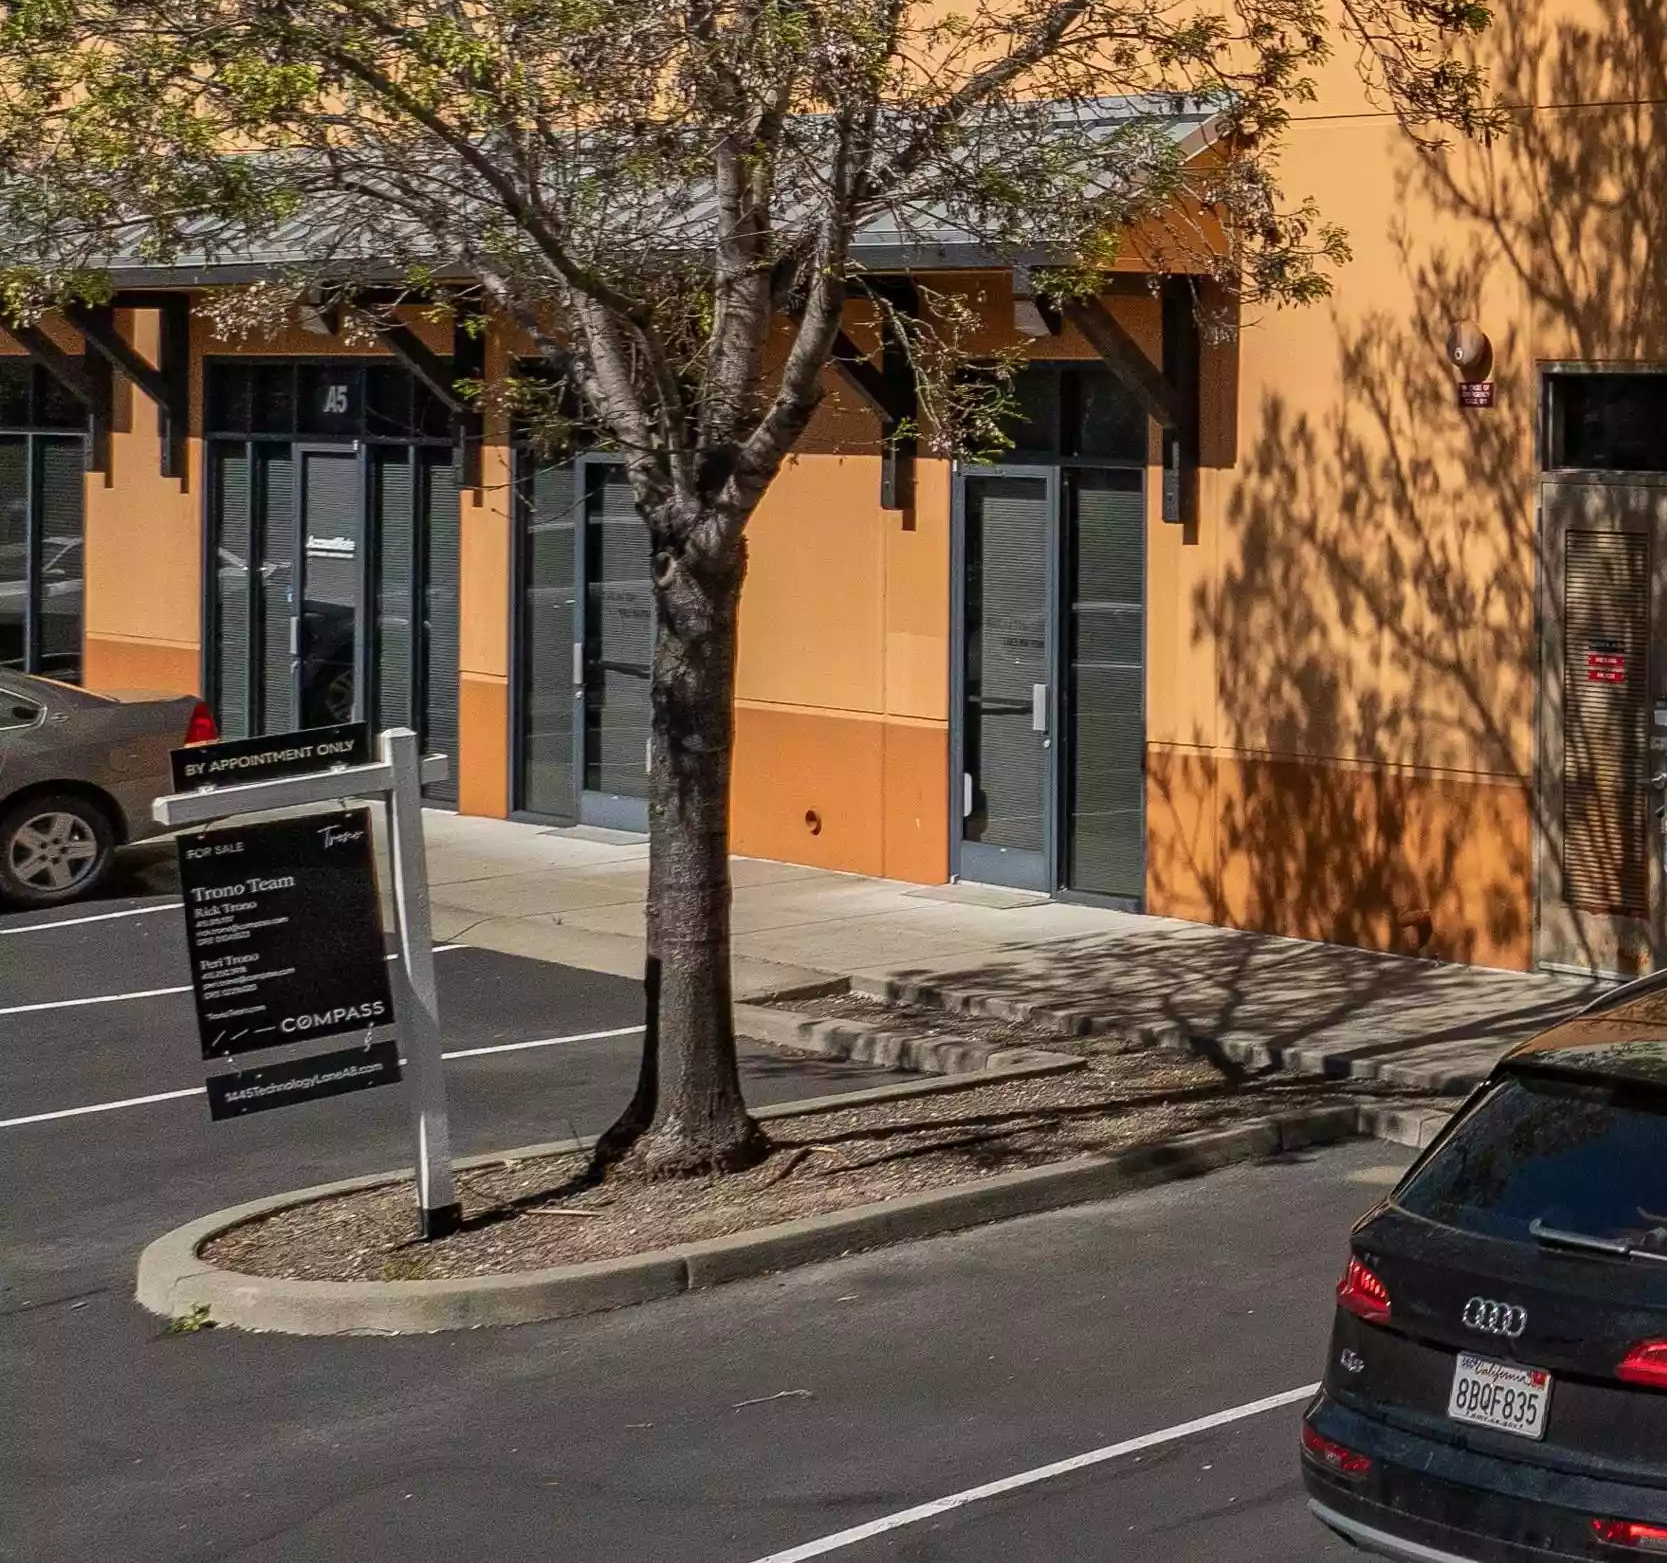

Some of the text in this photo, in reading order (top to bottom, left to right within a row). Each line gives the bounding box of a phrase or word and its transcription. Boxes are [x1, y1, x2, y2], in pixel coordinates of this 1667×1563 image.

[323, 385, 348, 413] A5
[185, 740, 355, 776] BY APPOINTMENT ONLY
[186, 841, 245, 859] FOR SALE
[190, 875, 296, 902] Trono Team
[194, 901, 258, 918] Rick Trono
[223, 953, 260, 966] Trono
[280, 1000, 386, 1033] COMPASS
[1475, 1359, 1531, 1385] California
[1456, 1378, 1539, 1425] 8BQF835
